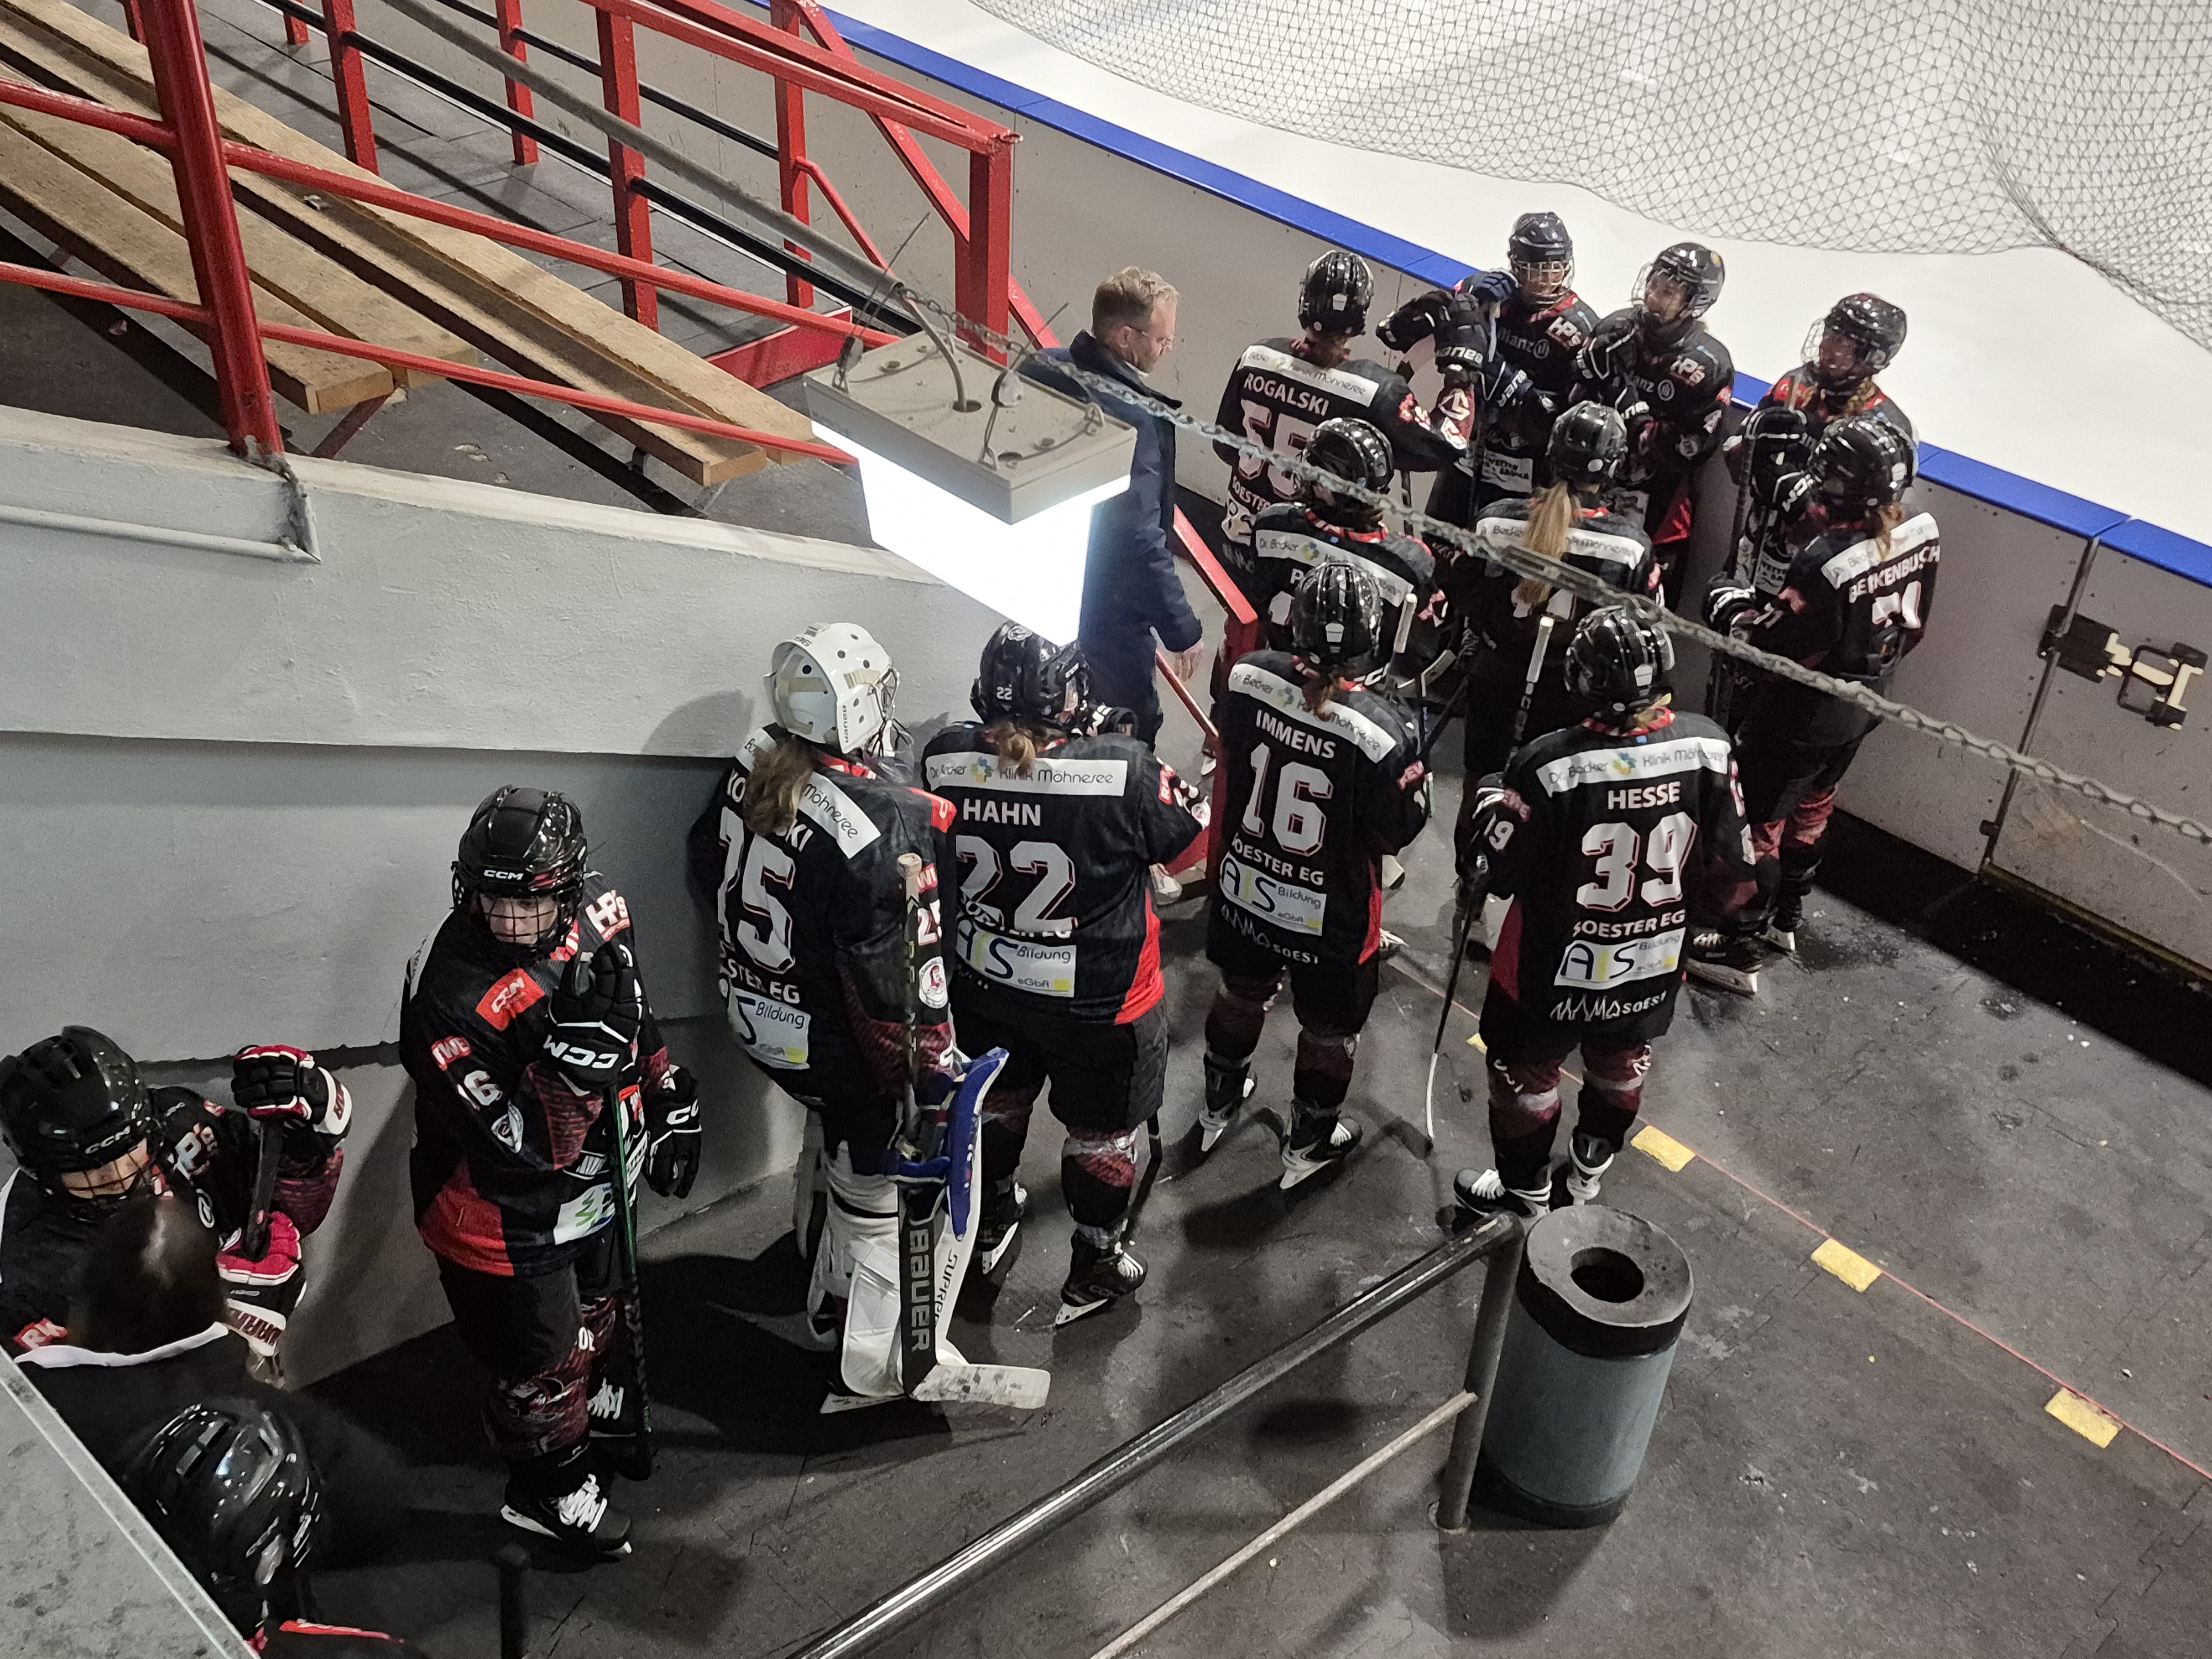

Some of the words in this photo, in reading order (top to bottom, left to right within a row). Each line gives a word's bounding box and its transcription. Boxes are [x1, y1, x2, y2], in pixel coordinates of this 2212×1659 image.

[1496, 326, 1534, 351] llianz
[1244, 372, 1330, 416] ROGALSKI
[996, 685, 1013, 701] 22
[1255, 709, 1337, 759] IMMENS
[1037, 769, 1114, 784] Möhnesee
[1241, 742, 1333, 857] 16
[1608, 781, 1682, 810] HESSE
[963, 798, 1041, 827] HAHN
[483, 869, 523, 881] CCM
[1299, 866, 1324, 885] EG
[1576, 811, 1698, 912] 39
[955, 834, 1078, 933] 22
[1277, 886, 1322, 910] Bildung
[1660, 909, 1686, 927] EG
[1016, 946, 1072, 964] Bildung
[769, 980, 801, 1005] EG
[755, 1001, 806, 1030] Bildung
[910, 1228, 930, 1352] BAUER
[935, 1248, 958, 1327] SUPRE
